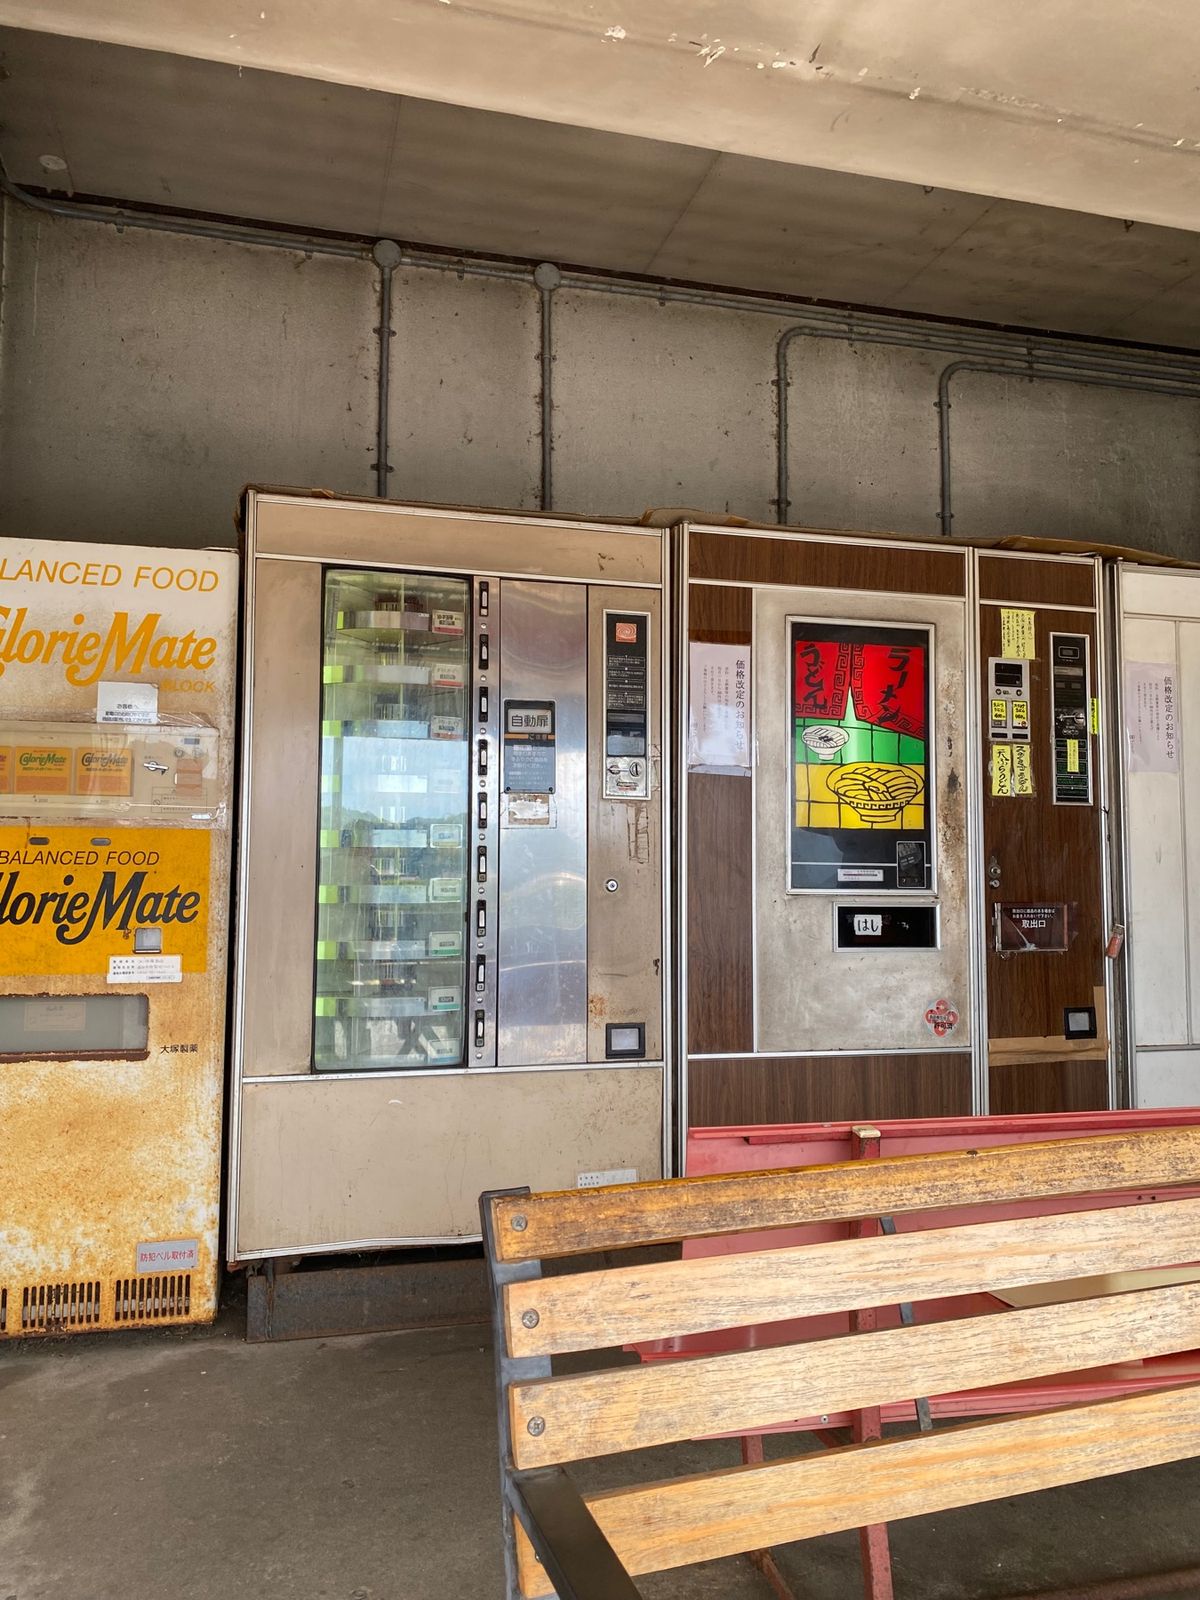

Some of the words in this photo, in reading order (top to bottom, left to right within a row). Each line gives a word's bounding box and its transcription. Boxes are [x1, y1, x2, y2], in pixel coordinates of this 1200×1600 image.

[133, 566, 219, 592] FOOD
[800, 643, 828, 709] うどん
[877, 647, 912, 723] ラーメン
[511, 714, 549, 728] 自動扉
[1163, 676, 1175, 759] 価格改定のお知らせ
[0, 850, 98, 865] BALANCED
[106, 851, 160, 866] FOOD
[857, 918, 879, 932] はし
[1021, 919, 1046, 928] 取出口
[160, 1044, 198, 1054] 大塚製薬
[140, 1250, 194, 1262] 防犯ベル取付済
